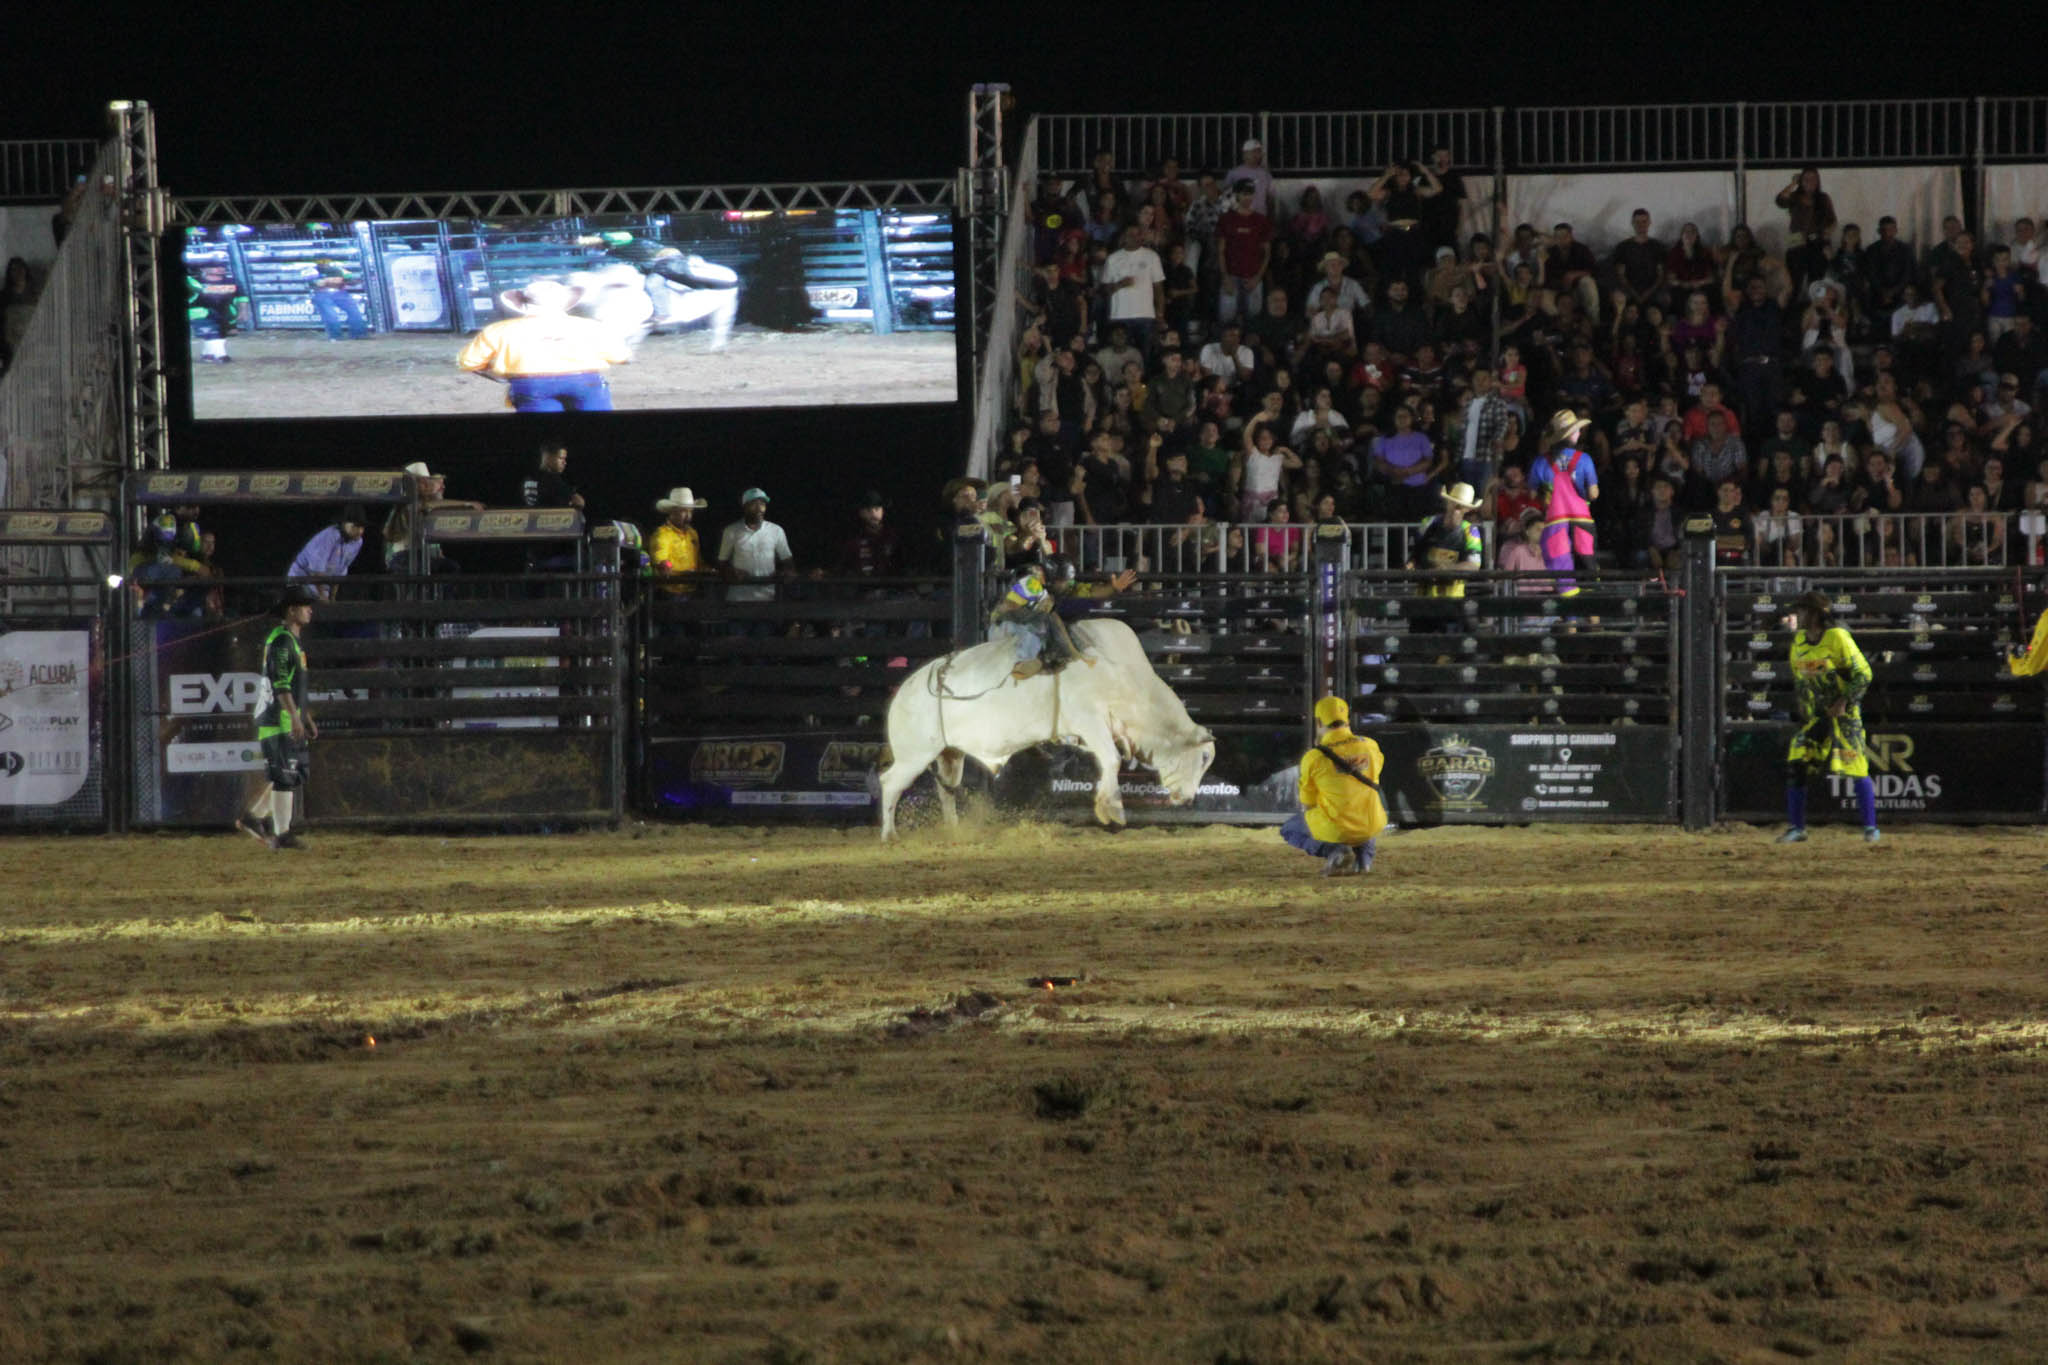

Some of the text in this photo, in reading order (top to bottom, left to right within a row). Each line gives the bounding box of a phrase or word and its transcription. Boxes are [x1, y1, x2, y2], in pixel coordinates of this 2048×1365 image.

[30, 659, 78, 685] ACUBÁ
[1052, 780, 1093, 792] Nilmo
[1191, 782, 1241, 796] ventos
